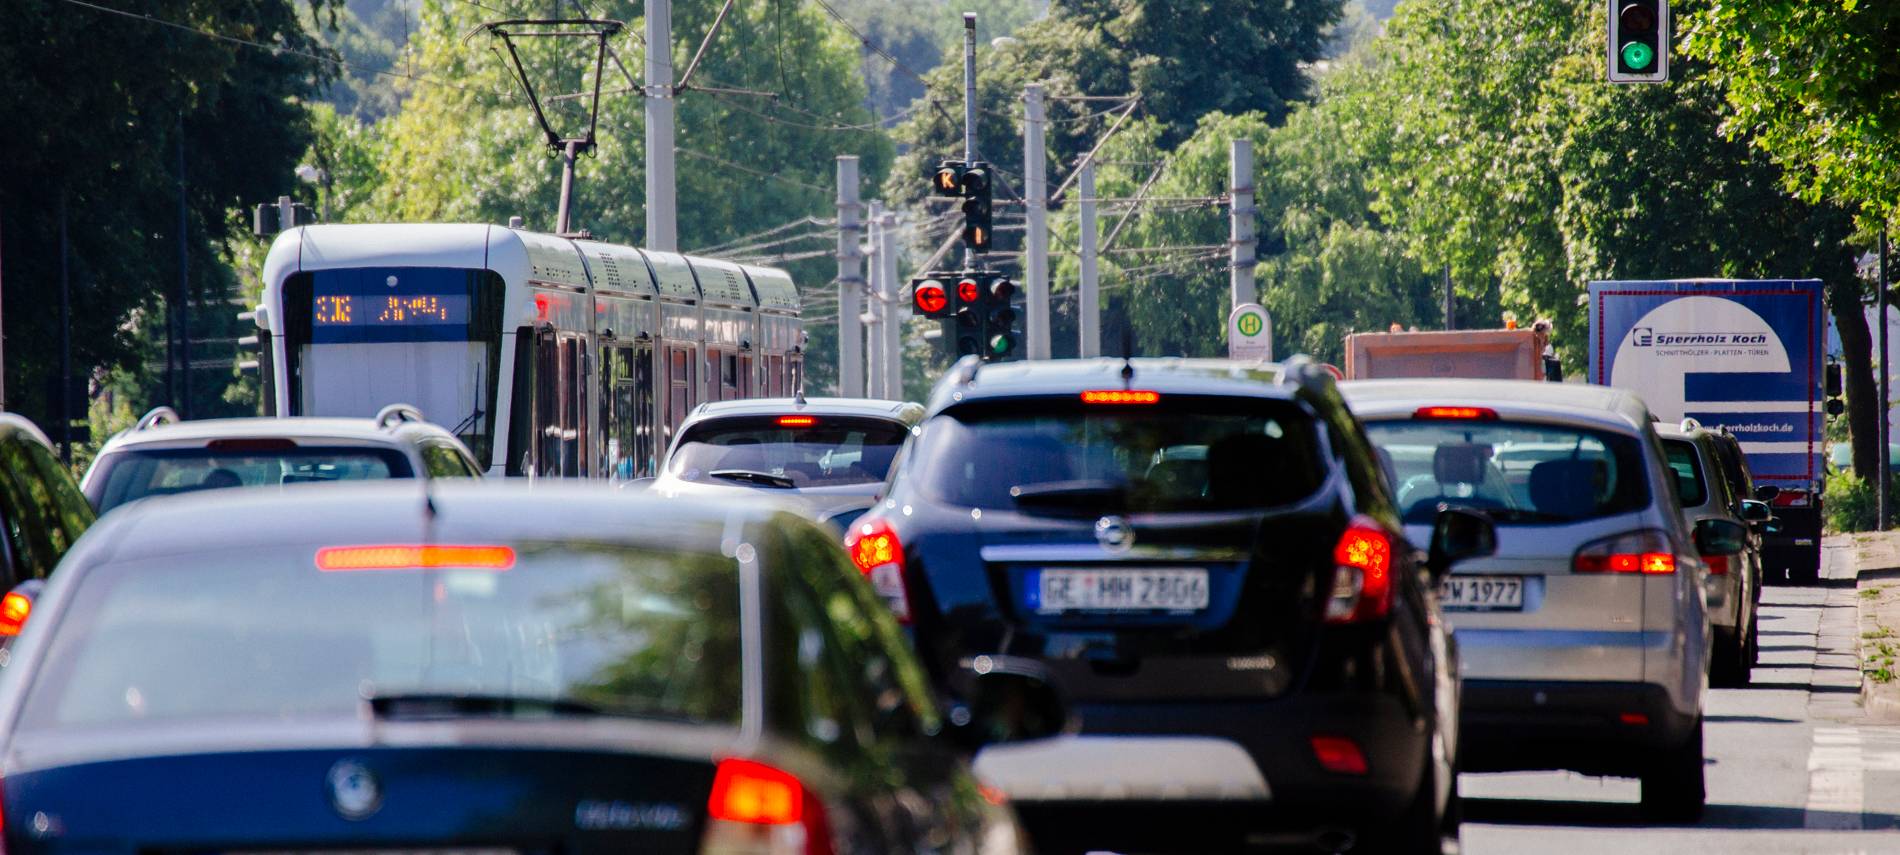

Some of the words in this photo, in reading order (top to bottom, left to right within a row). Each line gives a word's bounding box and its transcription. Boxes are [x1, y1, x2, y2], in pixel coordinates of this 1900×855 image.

[941, 173, 955, 188] K
[1245, 318, 1256, 331] H
[1656, 335, 1727, 345] Sperrholz
[1732, 335, 1766, 344] Koch
[1470, 581, 1518, 603] 1977
